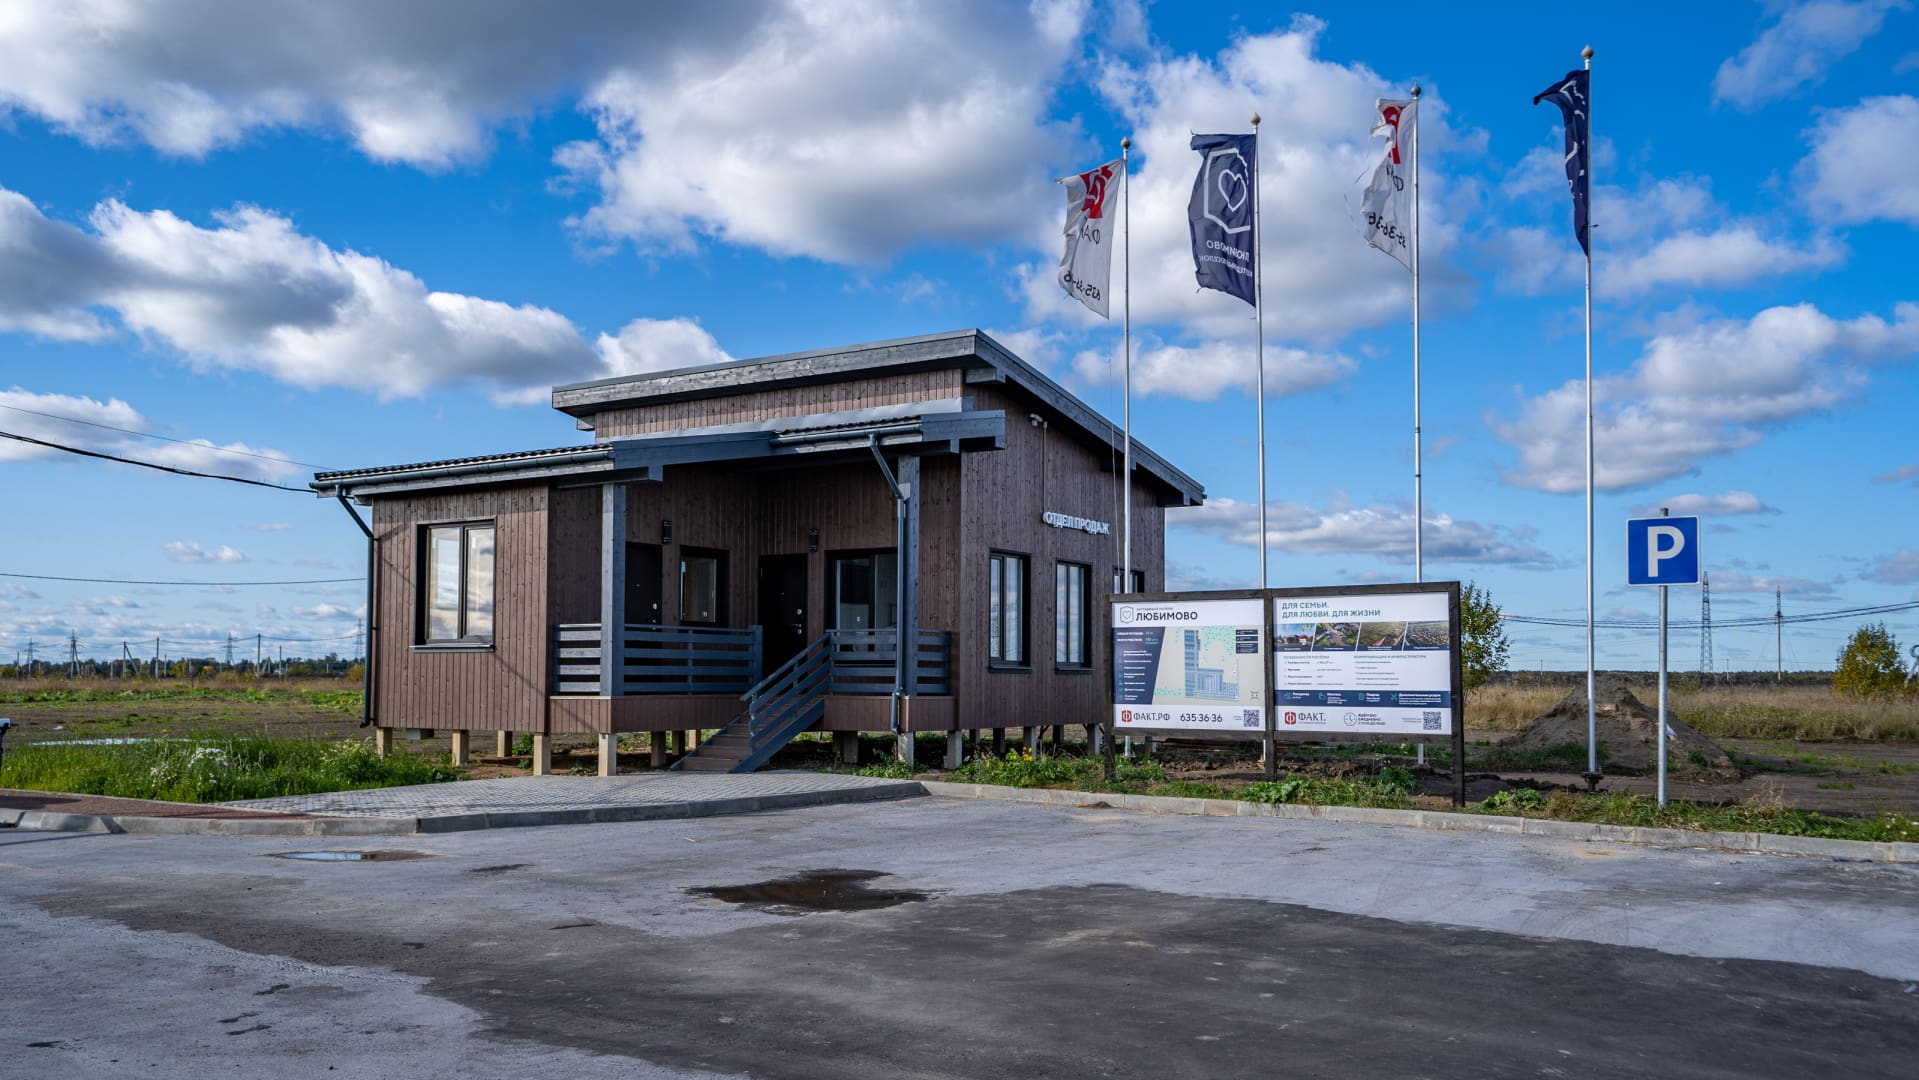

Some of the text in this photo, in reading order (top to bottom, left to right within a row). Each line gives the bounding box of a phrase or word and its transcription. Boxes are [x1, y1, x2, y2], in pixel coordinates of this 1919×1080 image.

[1043, 511, 1111, 535] ОТДЕЛ ПРОДАЖ
[1647, 525, 1685, 577] P
[1281, 602, 1298, 610] ДЛЯ
[1135, 611, 1198, 621] ЛЮБИМОВО
[1281, 611, 1299, 619] ДЛЯ
[1133, 712, 1171, 721] ФАКТ.РФ
